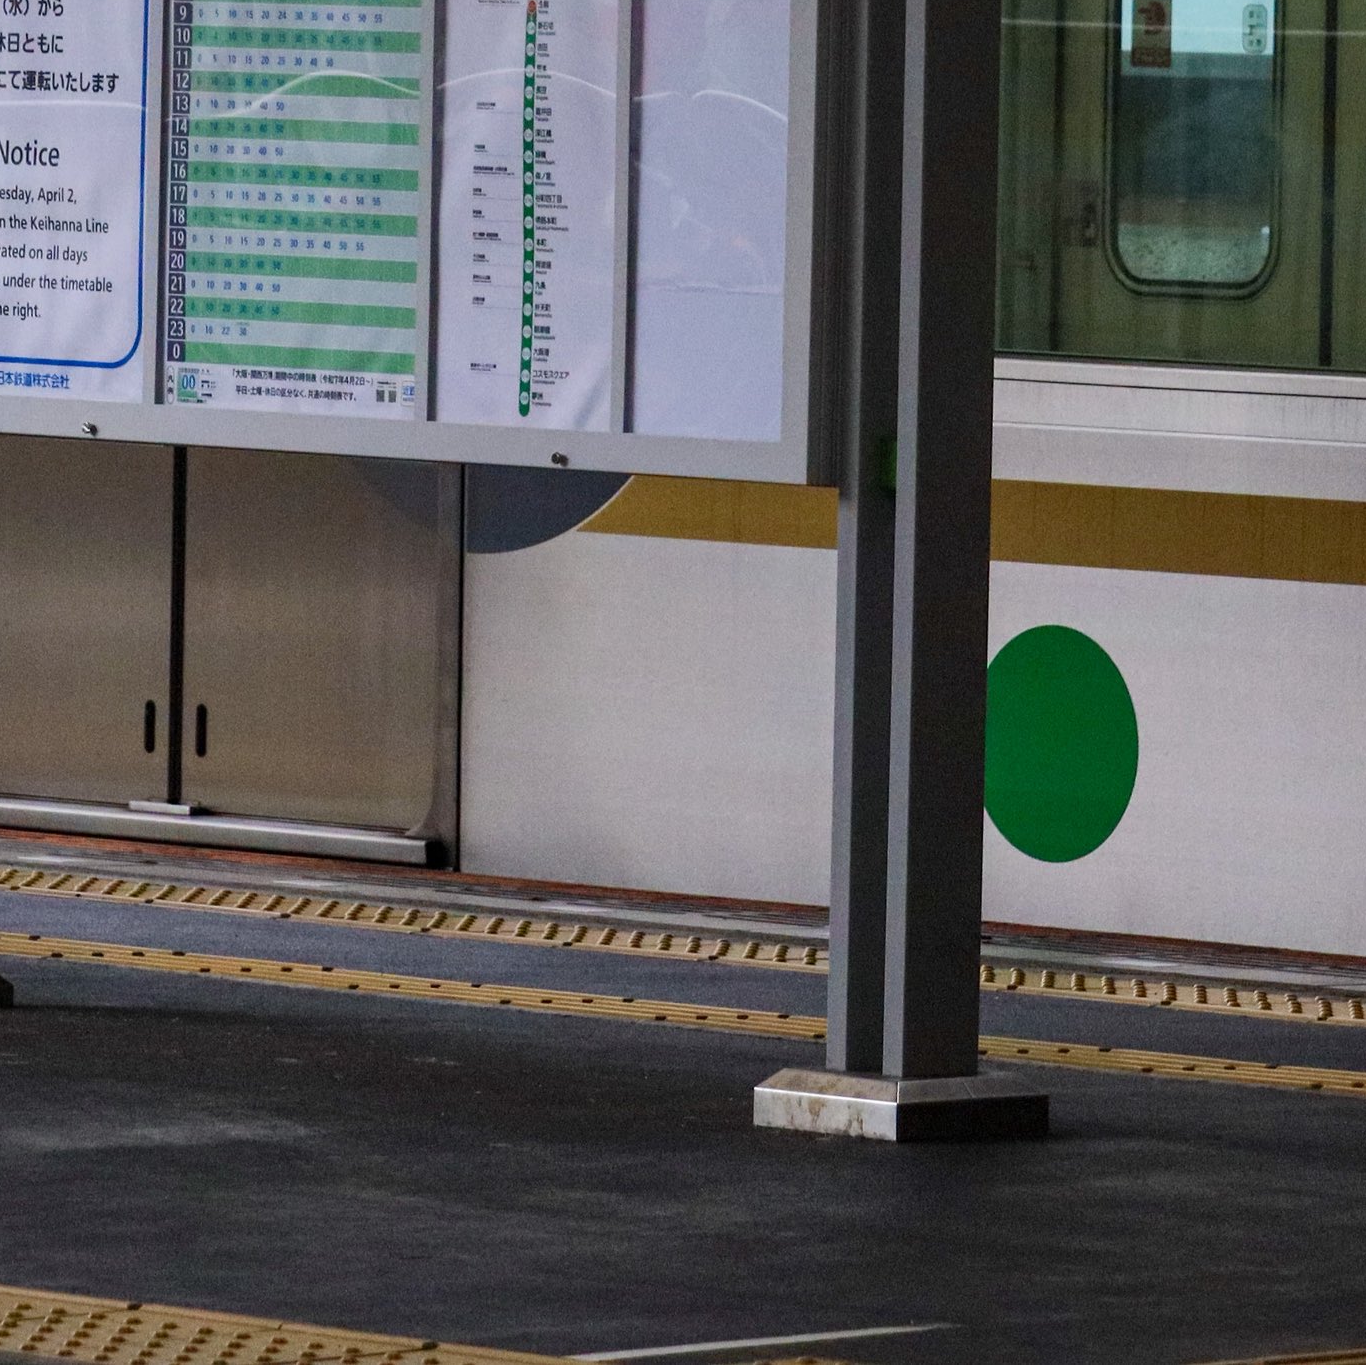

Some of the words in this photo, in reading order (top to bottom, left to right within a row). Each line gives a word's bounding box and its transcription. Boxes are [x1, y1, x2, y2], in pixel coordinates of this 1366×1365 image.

[180, 6, 186, 20] 9
[177, 28, 190, 43] 10
[177, 51, 188, 65] 11
[177, 73, 189, 88] 12
[176, 95, 188, 110] 13
[174, 117, 188, 133] 14
[174, 141, 186, 156] 15
[174, 164, 186, 178] 16
[38, 188, 64, 205] April
[68, 189, 76, 204] 2,
[173, 186, 185, 201] 17
[173, 208, 184, 223] 18
[9, 214, 27, 229] the
[31, 216, 82, 232] Keihanna
[86, 219, 108, 233] Line
[172, 231, 184, 245] 19
[29, 249, 43, 259] on
[47, 245, 59, 259] all
[63, 246, 87, 265] days
[171, 253, 183, 268] 20
[3, 273, 35, 288] under
[39, 275, 57, 289] the
[61, 276, 112, 292] timetable
[171, 276, 182, 291] 21
[13, 302, 41, 320] right.
[171, 298, 183, 313] 22
[170, 321, 183, 336] 23
[173, 344, 180, 358] 0
